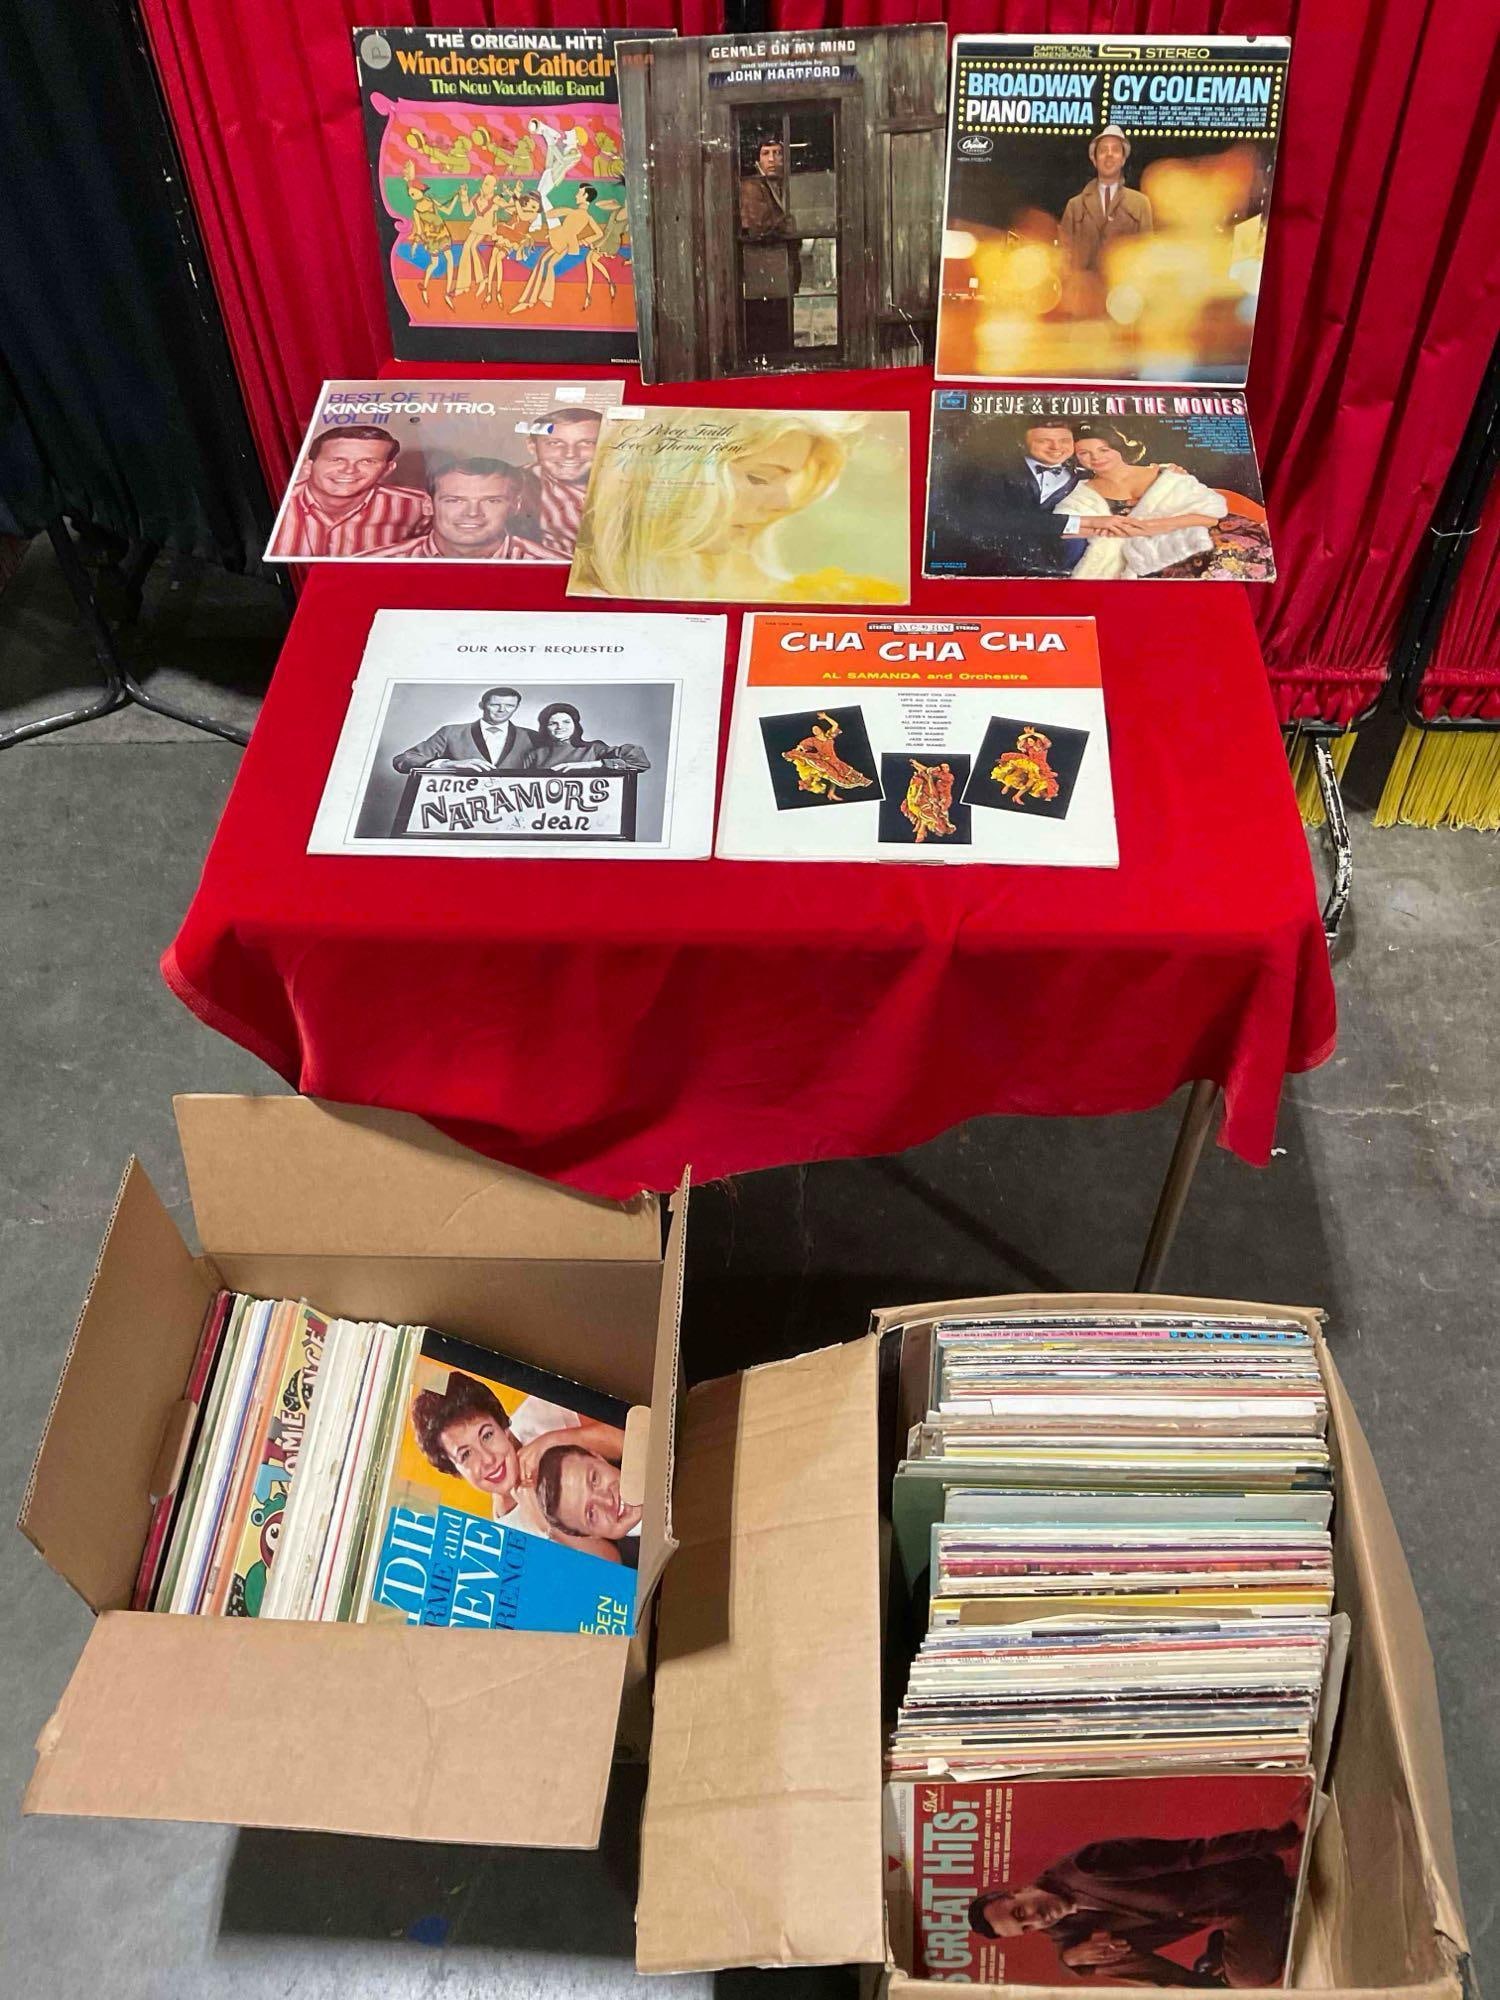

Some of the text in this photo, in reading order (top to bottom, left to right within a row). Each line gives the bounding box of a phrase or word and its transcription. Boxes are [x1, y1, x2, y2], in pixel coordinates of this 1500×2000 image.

[426, 33, 603, 50] THE ORIGINAL HIT!
[711, 40, 856, 59] GENTLE ON MY MIND
[1146, 48, 1210, 58] STEREO
[396, 50, 520, 76] Winchester
[524, 52, 617, 77] Cathedr
[727, 66, 840, 82] JOHN HARTFORD
[430, 78, 604, 96] The New Vaudeville Band
[968, 72, 1098, 98] BROADWAY
[1113, 74, 1272, 104] CY COLEMAN
[966, 100, 1094, 124] PIANORAMA
[328, 392, 470, 404] BEST OF THE
[972, 396, 1245, 416] STEVE & EYDIE AT THE MOVIES
[323, 402, 437, 414] KINGSTON
[372, 414, 390, 424] III
[457, 644, 624, 654] OUR MOST REQUESTED
[780, 631, 864, 652] CHA
[979, 631, 1068, 652] CHA
[879, 641, 966, 662] CHA
[822, 672, 1029, 681] AL SAMANDA and Orchestra
[425, 778, 478, 793] anne
[420, 778, 610, 831] NARAMORS
[532, 812, 590, 831] dean
[443, 1512, 463, 1559] and
[922, 1800, 980, 1874] HITS!
[922, 1878, 979, 1968] GREAT
